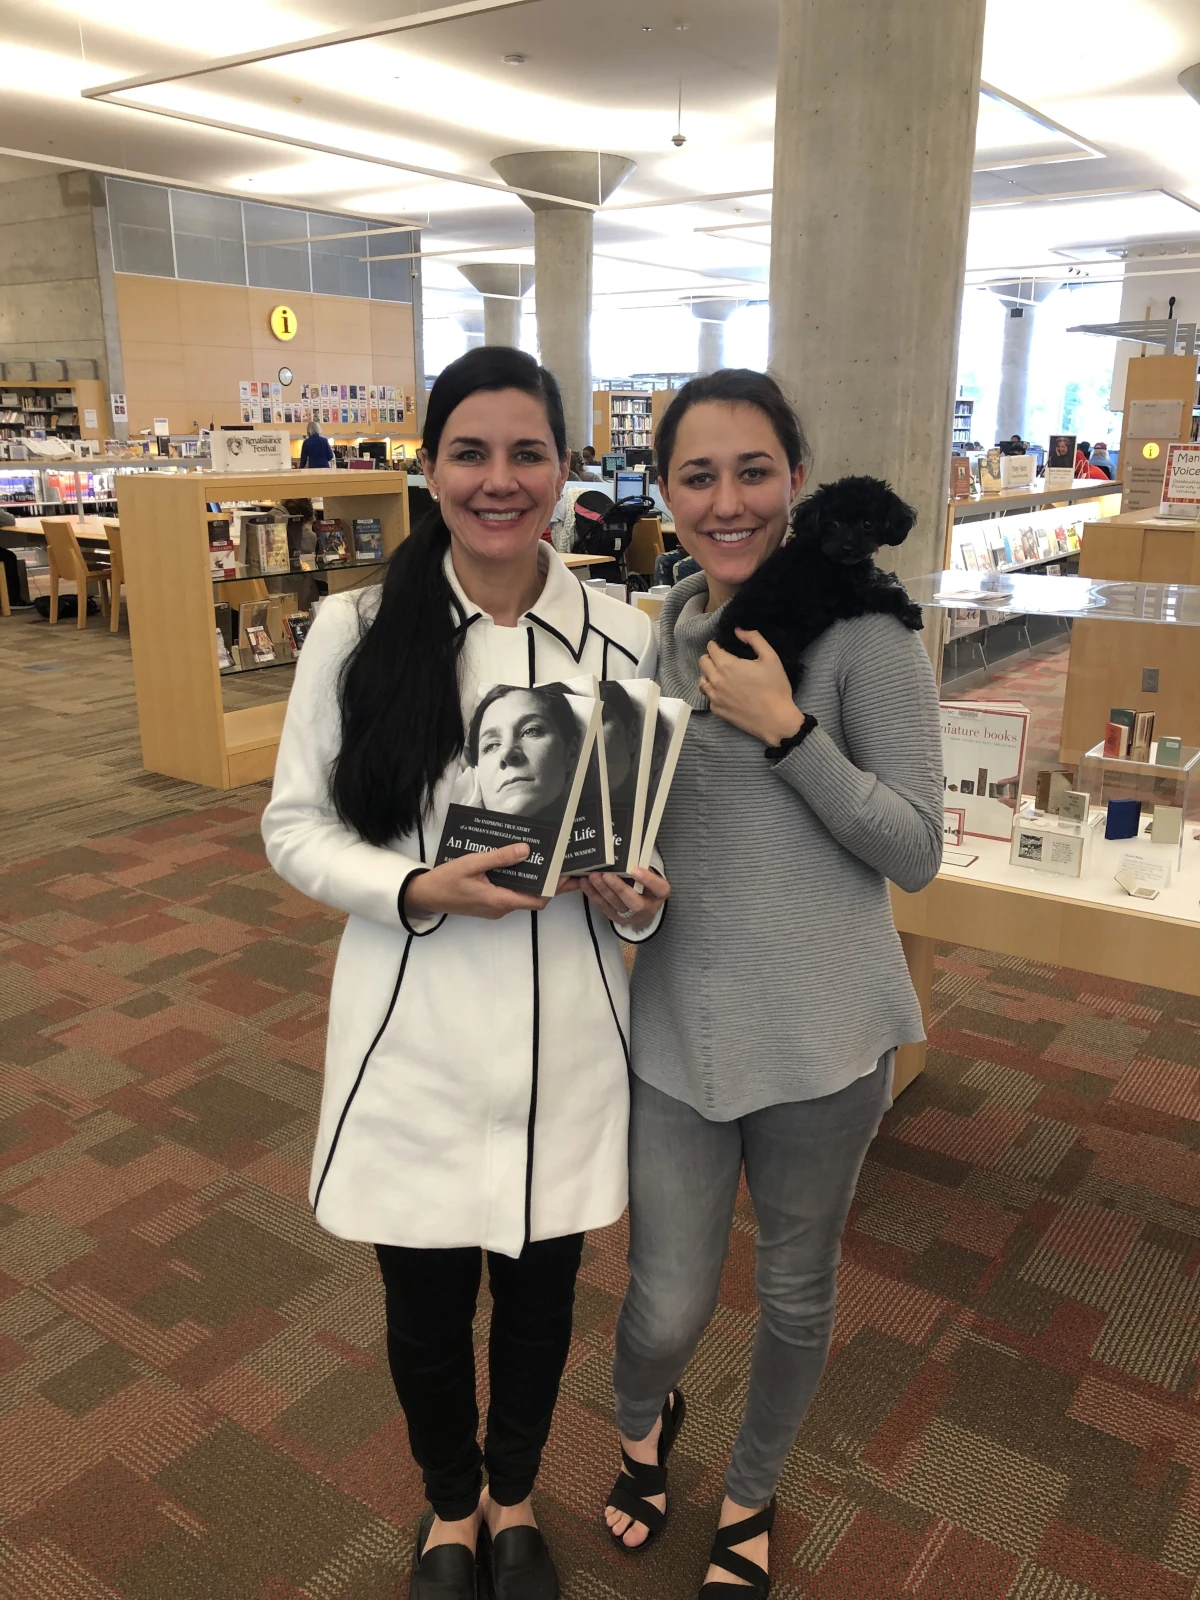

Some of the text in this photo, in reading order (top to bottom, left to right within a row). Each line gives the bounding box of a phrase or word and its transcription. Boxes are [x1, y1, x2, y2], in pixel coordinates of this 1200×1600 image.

[243, 436, 282, 446] Renaissance
[251, 445, 277, 453] Festival
[940, 722, 1018, 742] niature books
[481, 818, 504, 828] INSPIRING
[516, 825, 532, 833] STORY
[467, 825, 489, 834] WOMAN'S
[489, 829, 512, 839] STRUGGLE
[522, 836, 541, 845] WITHIN
[574, 827, 596, 842] Life
[446, 835, 462, 849] An
[574, 847, 597, 857] WASDEN
[517, 871, 539, 880] WASDEN
